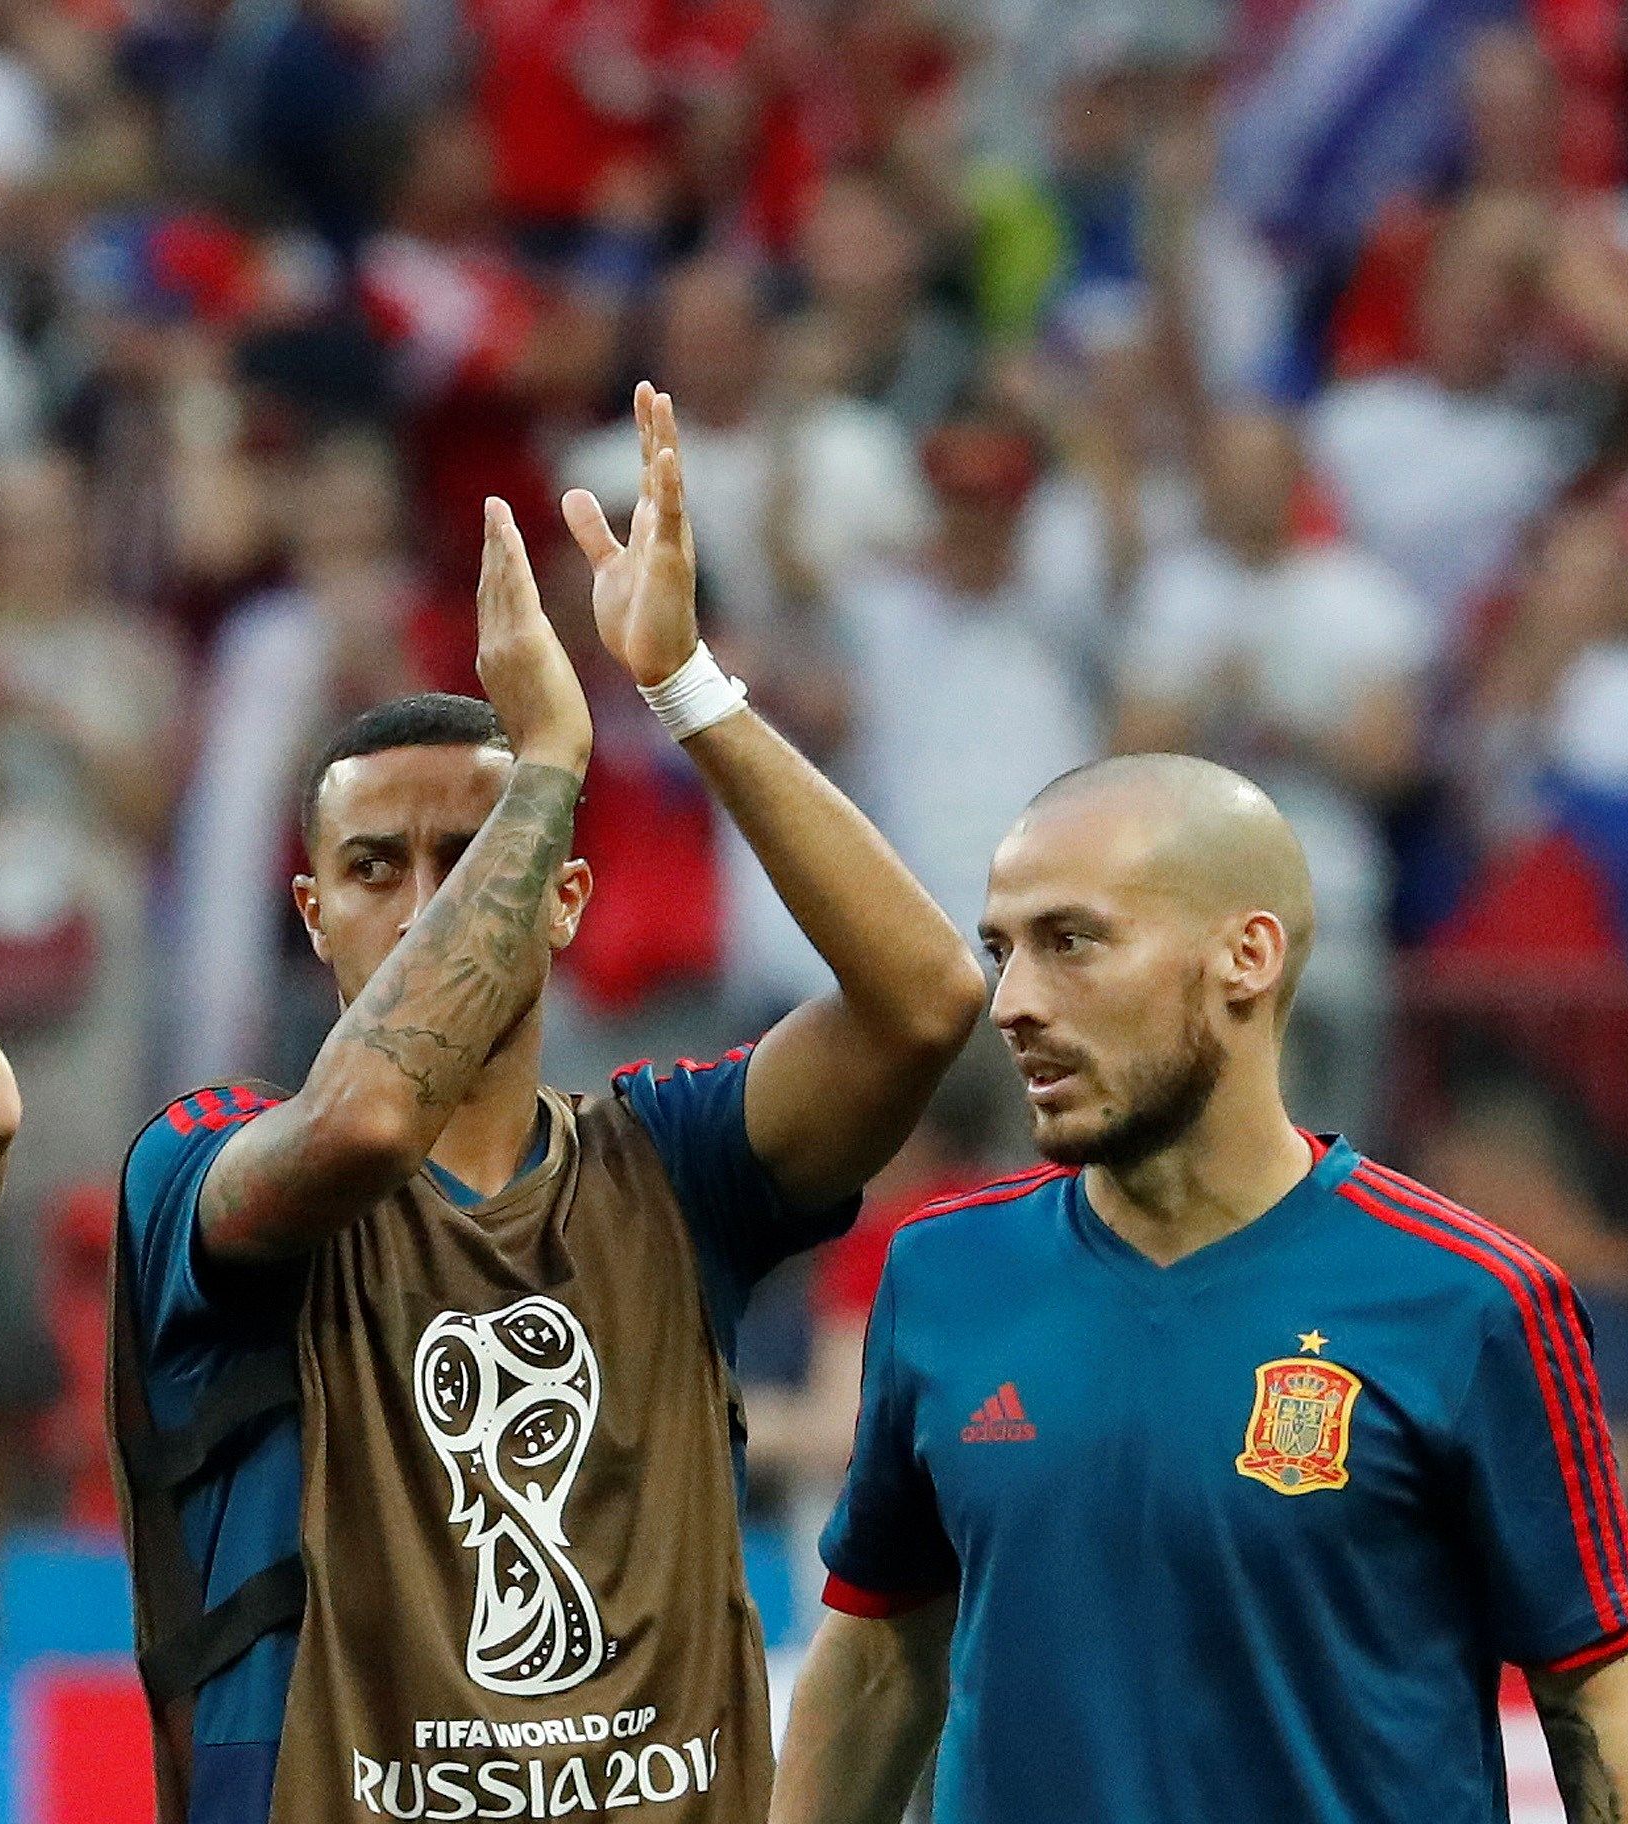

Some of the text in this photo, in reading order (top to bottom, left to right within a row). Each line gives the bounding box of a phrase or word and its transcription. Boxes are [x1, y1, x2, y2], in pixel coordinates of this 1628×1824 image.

[960, 1418, 1038, 1444] adidas
[414, 1705, 657, 1749] FIFA WORLD CUP
[352, 1727, 720, 1821] RUSSIA 201
